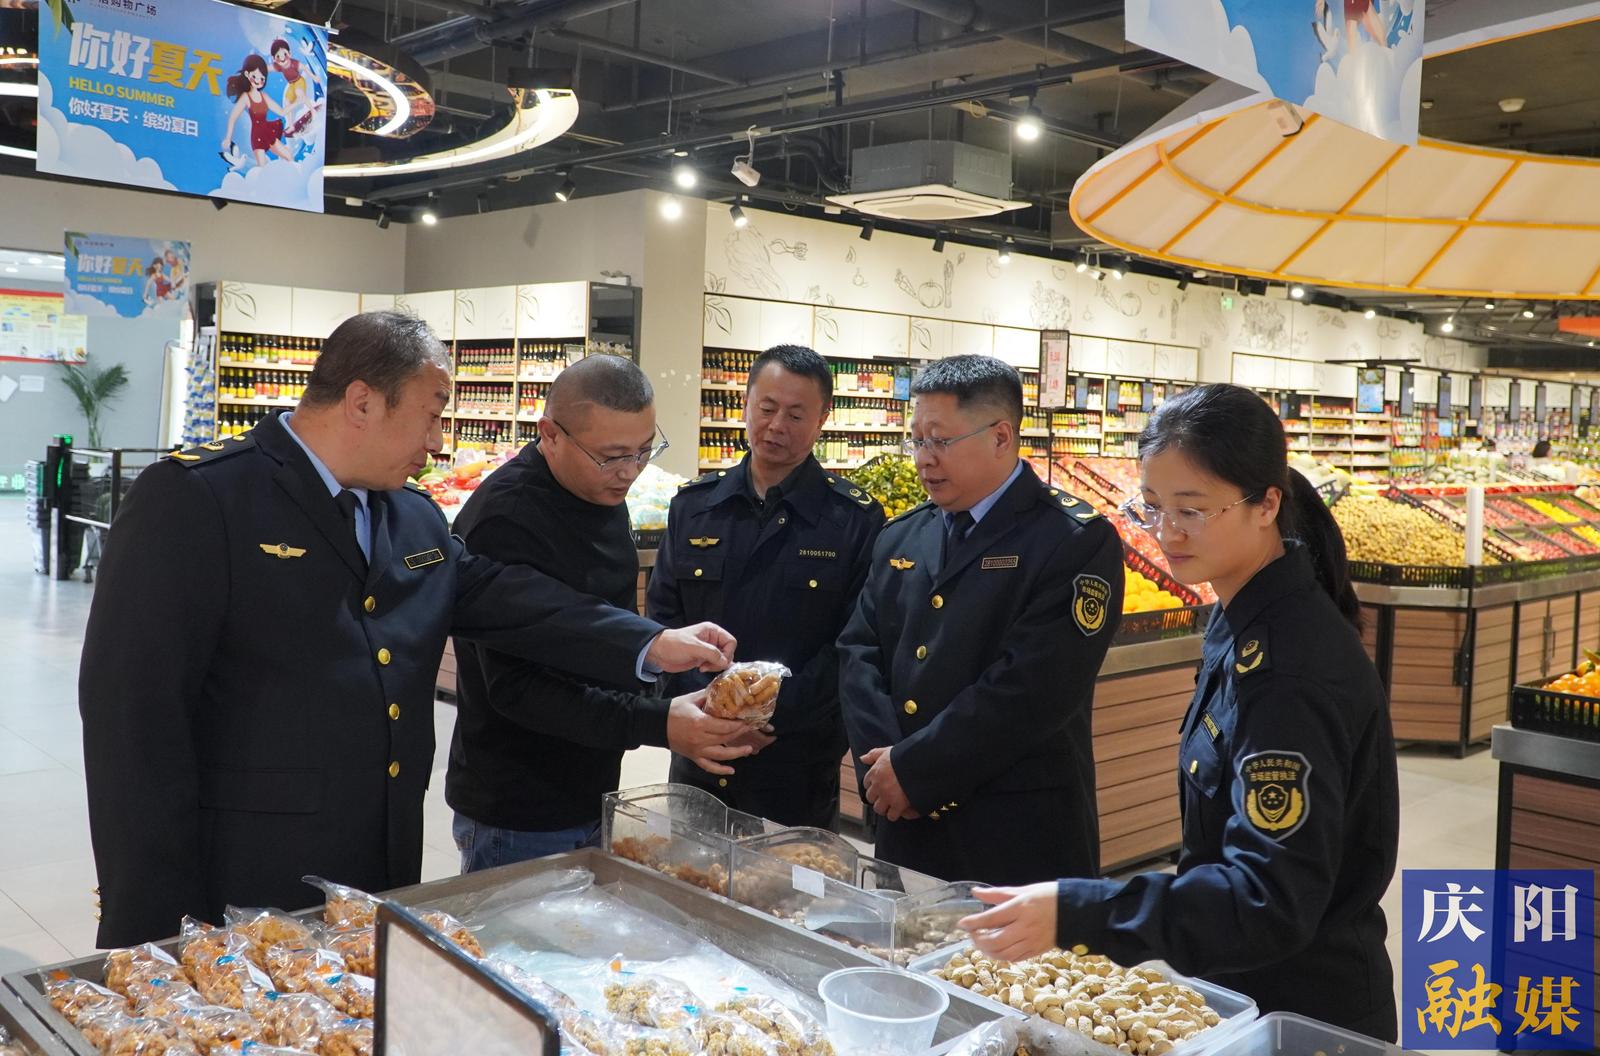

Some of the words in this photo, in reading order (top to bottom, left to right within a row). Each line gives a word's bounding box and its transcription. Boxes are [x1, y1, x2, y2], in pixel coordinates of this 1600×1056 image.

[68, 22, 222, 95] 你好夏天
[69, 77, 114, 96] HELLO
[117, 86, 175, 109] SUMMER
